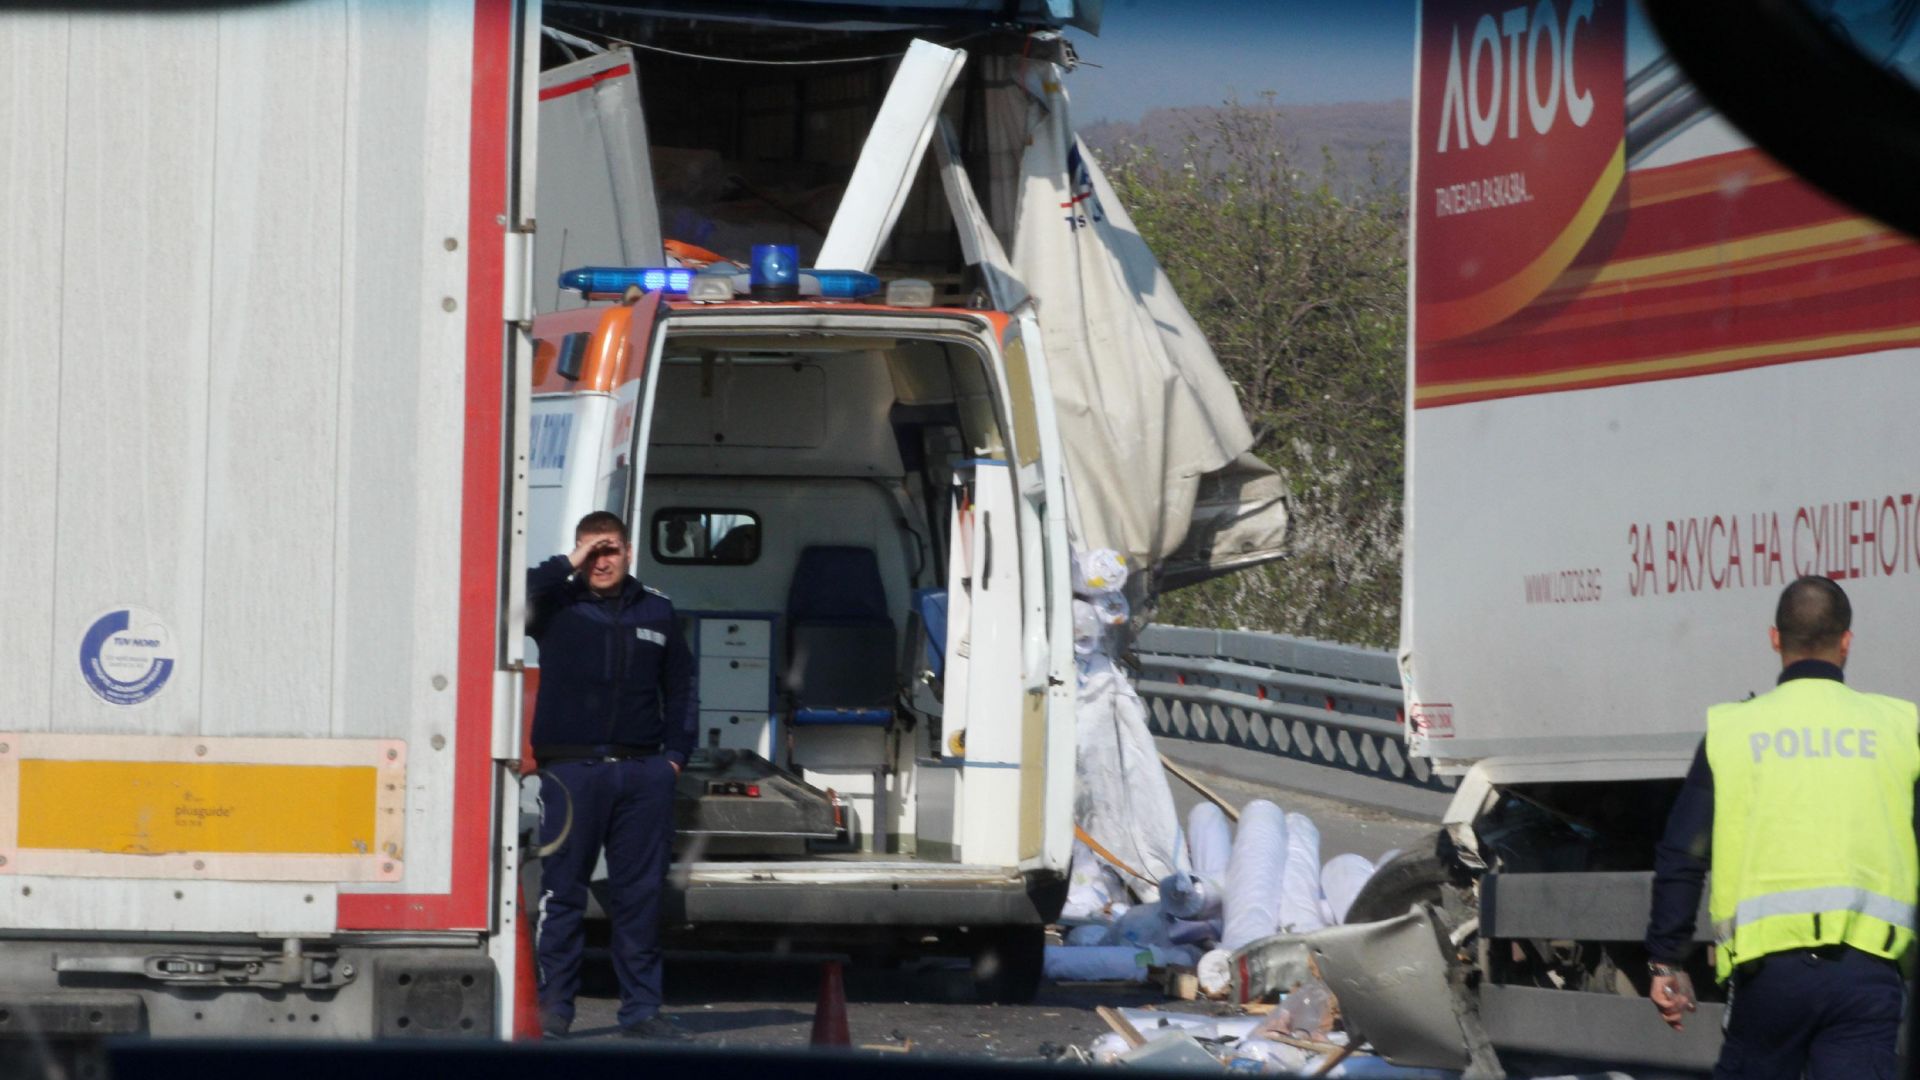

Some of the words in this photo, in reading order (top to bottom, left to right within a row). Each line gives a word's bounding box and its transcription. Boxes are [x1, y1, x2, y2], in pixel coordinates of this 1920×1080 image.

[1628, 522, 1658, 597] ЗА
[1665, 514, 1745, 593] ВКУСА
[1751, 511, 1785, 587] НА
[1749, 726, 1877, 764] POLICE
